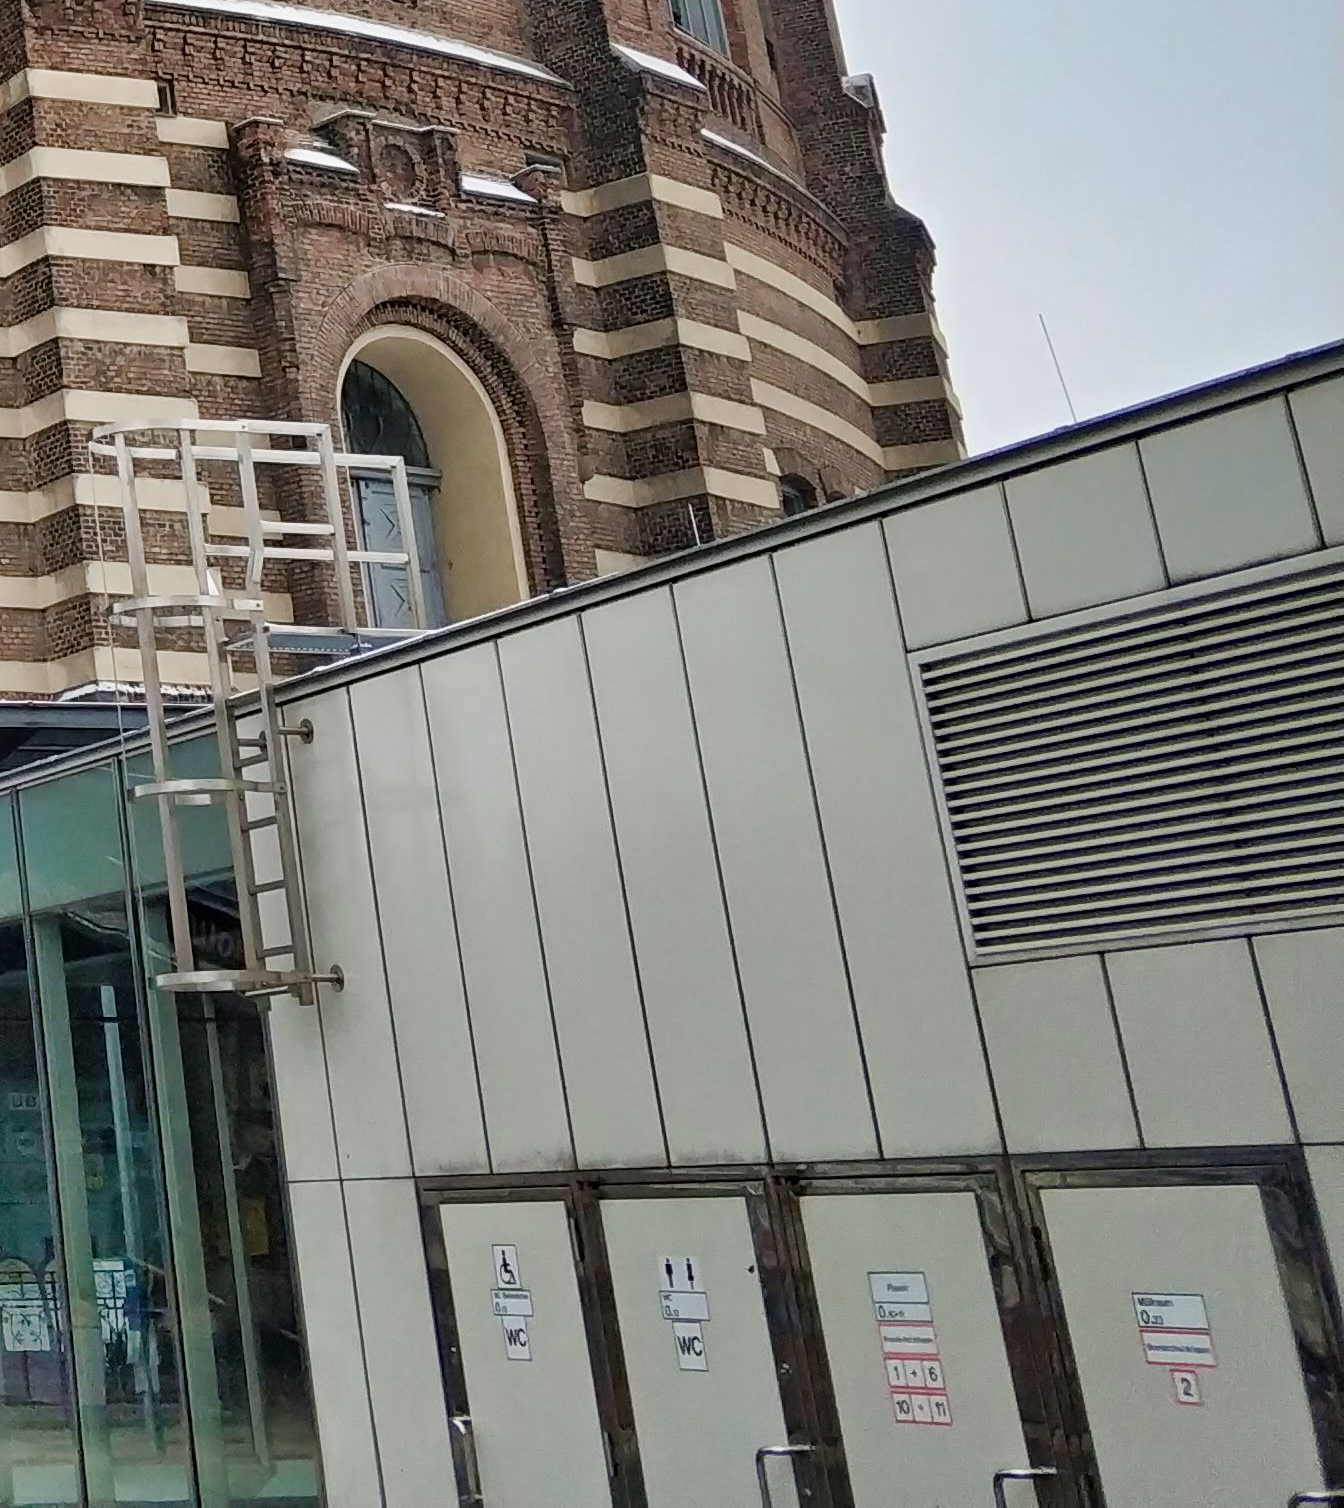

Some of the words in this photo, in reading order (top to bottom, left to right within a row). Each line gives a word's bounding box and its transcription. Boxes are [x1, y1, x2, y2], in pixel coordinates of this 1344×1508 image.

[505, 1328, 528, 1347] WC
[676, 1335, 703, 1357] WC
[928, 1366, 938, 1382] 6
[1180, 1377, 1194, 1398] 2
[896, 1399, 911, 1415] 10
